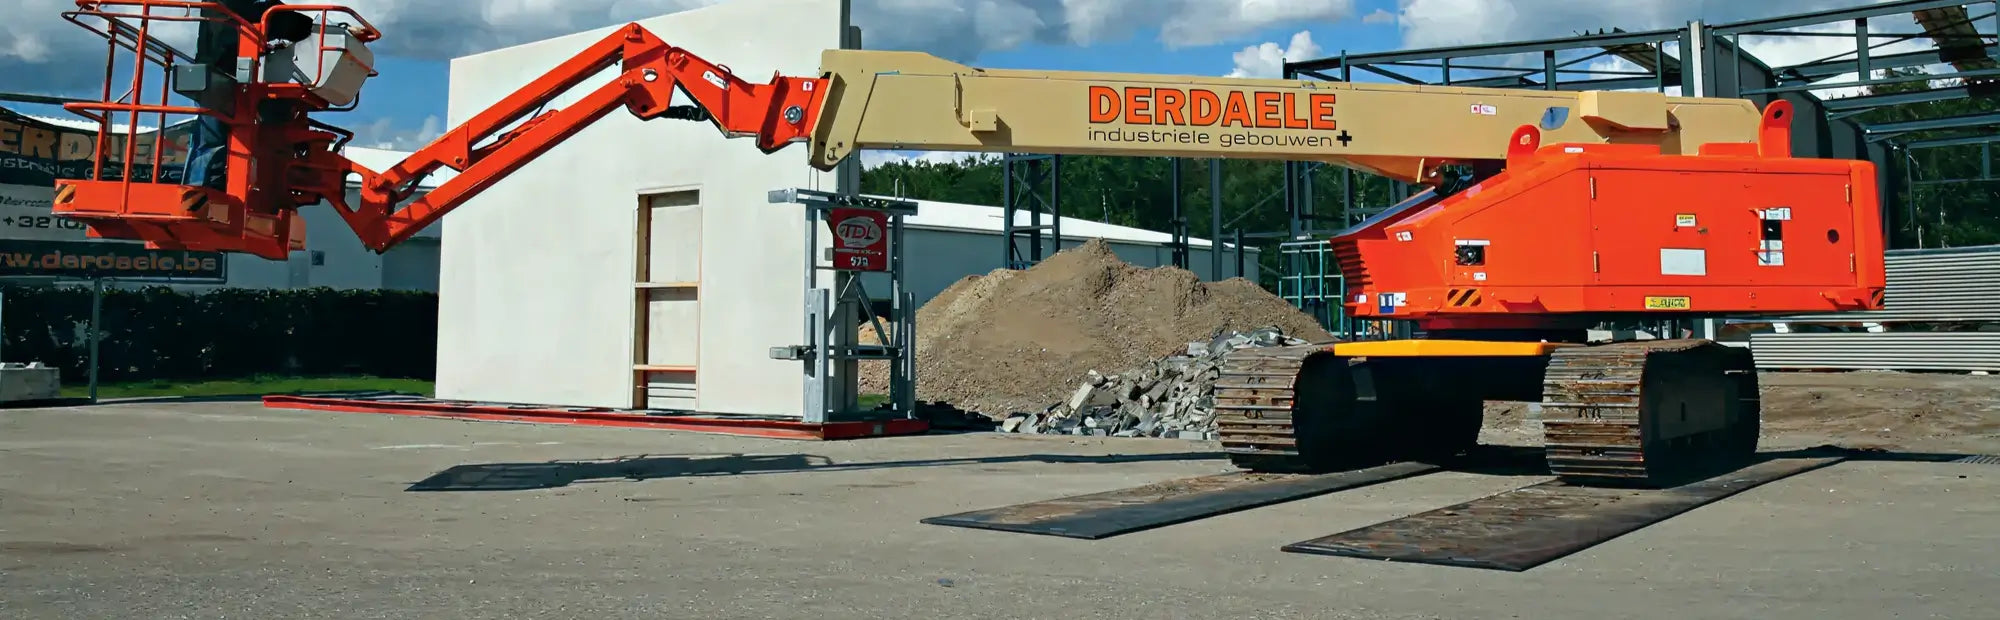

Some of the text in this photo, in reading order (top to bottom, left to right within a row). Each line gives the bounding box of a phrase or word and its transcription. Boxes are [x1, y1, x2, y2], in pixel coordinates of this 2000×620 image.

[1088, 85, 1337, 130] DERDAELE
[1088, 126, 1210, 144] industriele
[841, 223, 874, 240] TDL
